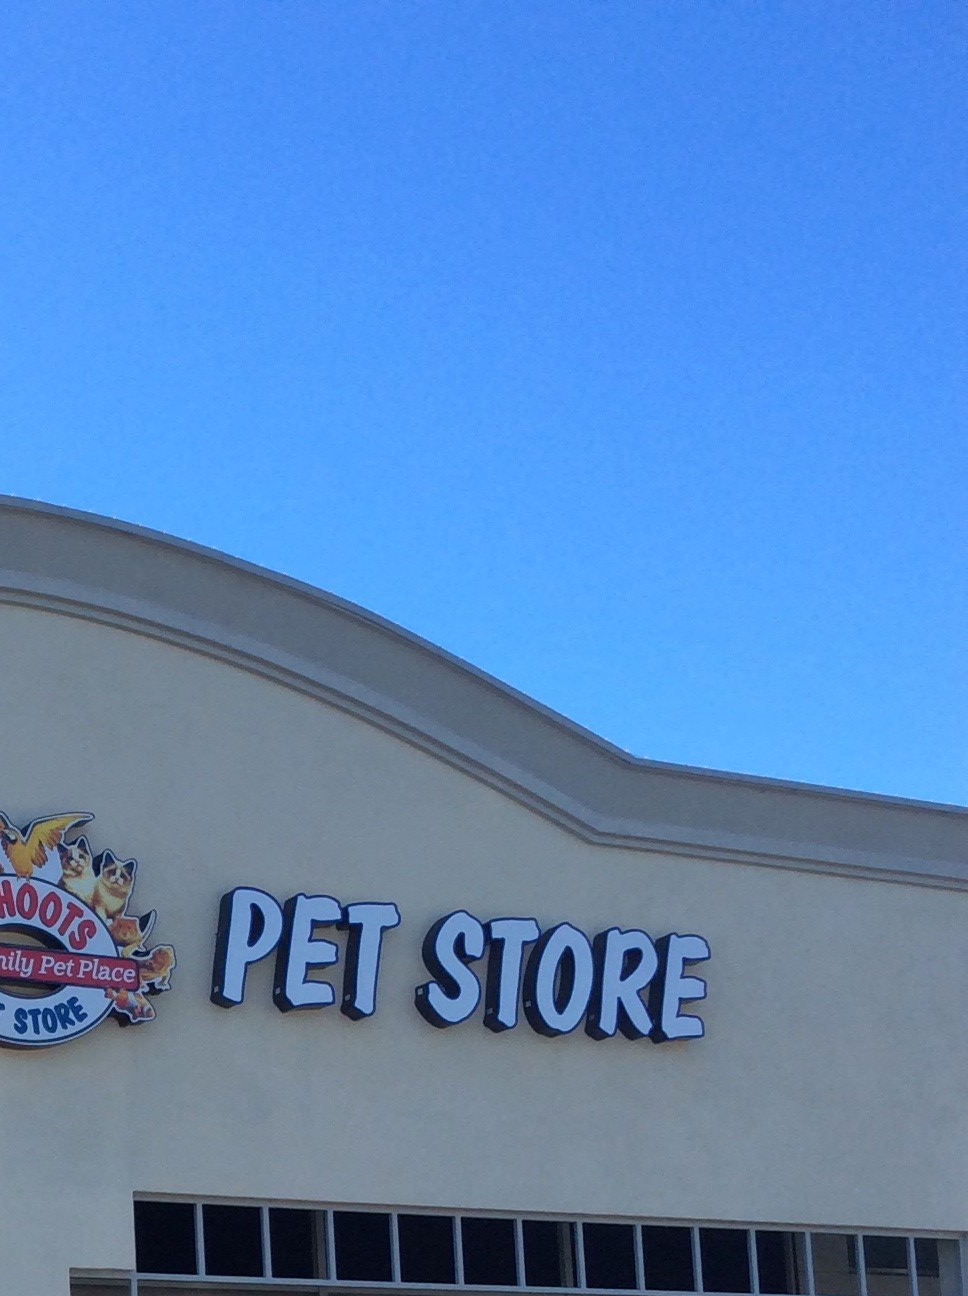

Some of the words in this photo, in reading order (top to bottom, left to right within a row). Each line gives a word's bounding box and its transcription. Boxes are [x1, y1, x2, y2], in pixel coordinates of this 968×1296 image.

[39, 956, 75, 977] Pet
[78, 958, 136, 983] Place
[211, 886, 402, 1021] PET
[415, 909, 712, 1043] STORE
[13, 996, 90, 1035] STORE
